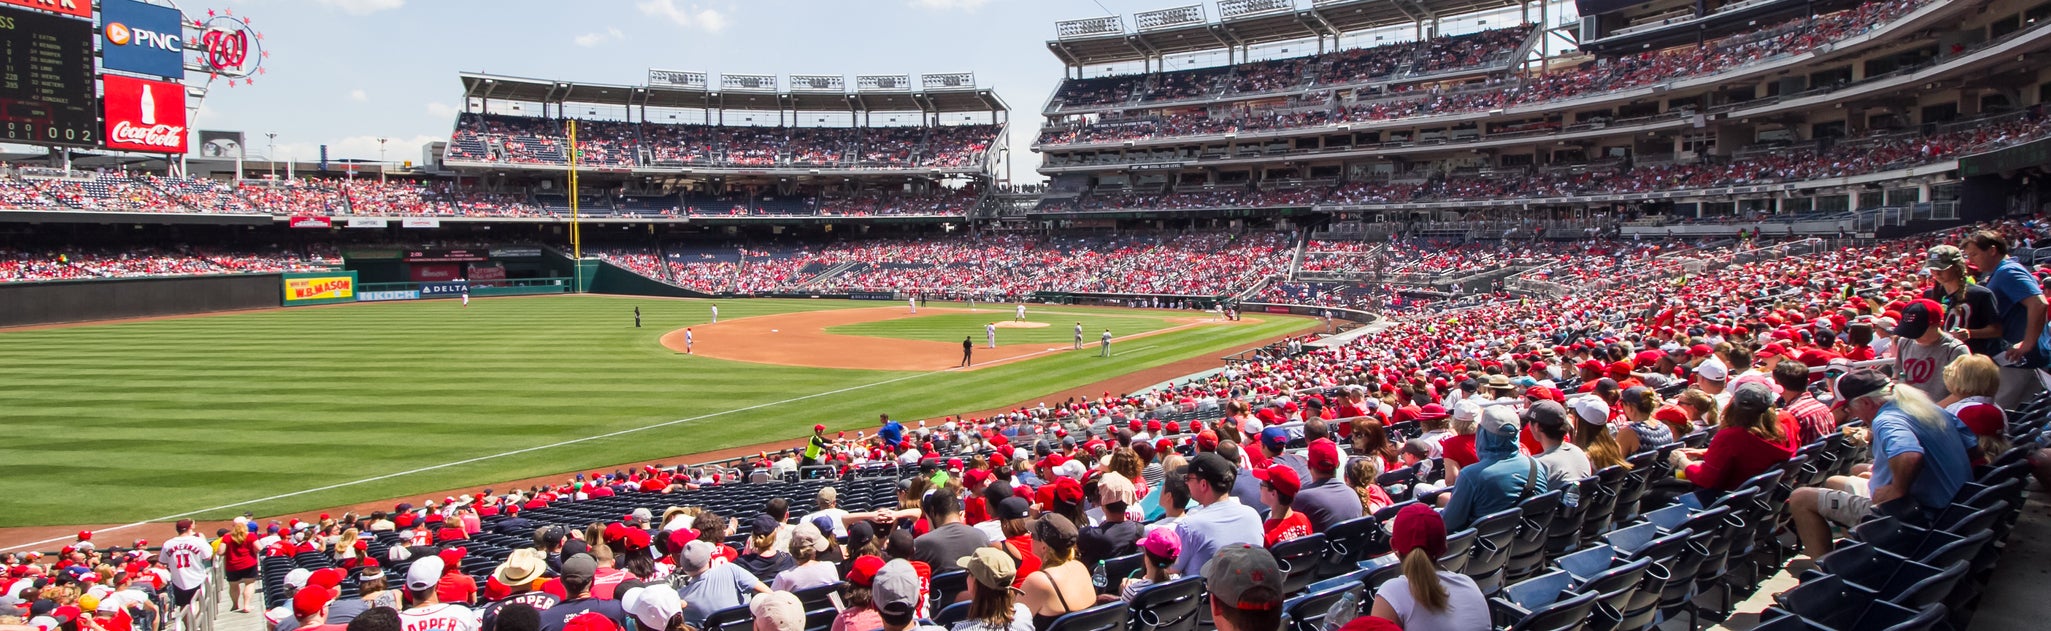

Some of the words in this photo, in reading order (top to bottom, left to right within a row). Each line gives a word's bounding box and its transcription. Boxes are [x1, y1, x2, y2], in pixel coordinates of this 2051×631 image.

[132, 27, 181, 52] PNC
[48, 127, 58, 139] 0
[65, 129, 74, 140] 0
[82, 130, 91, 141] 2
[112, 120, 183, 147] Coca-Cola
[433, 285, 467, 293] DELTA
[176, 553, 190, 568] 11
[493, 594, 555, 616] RPER
